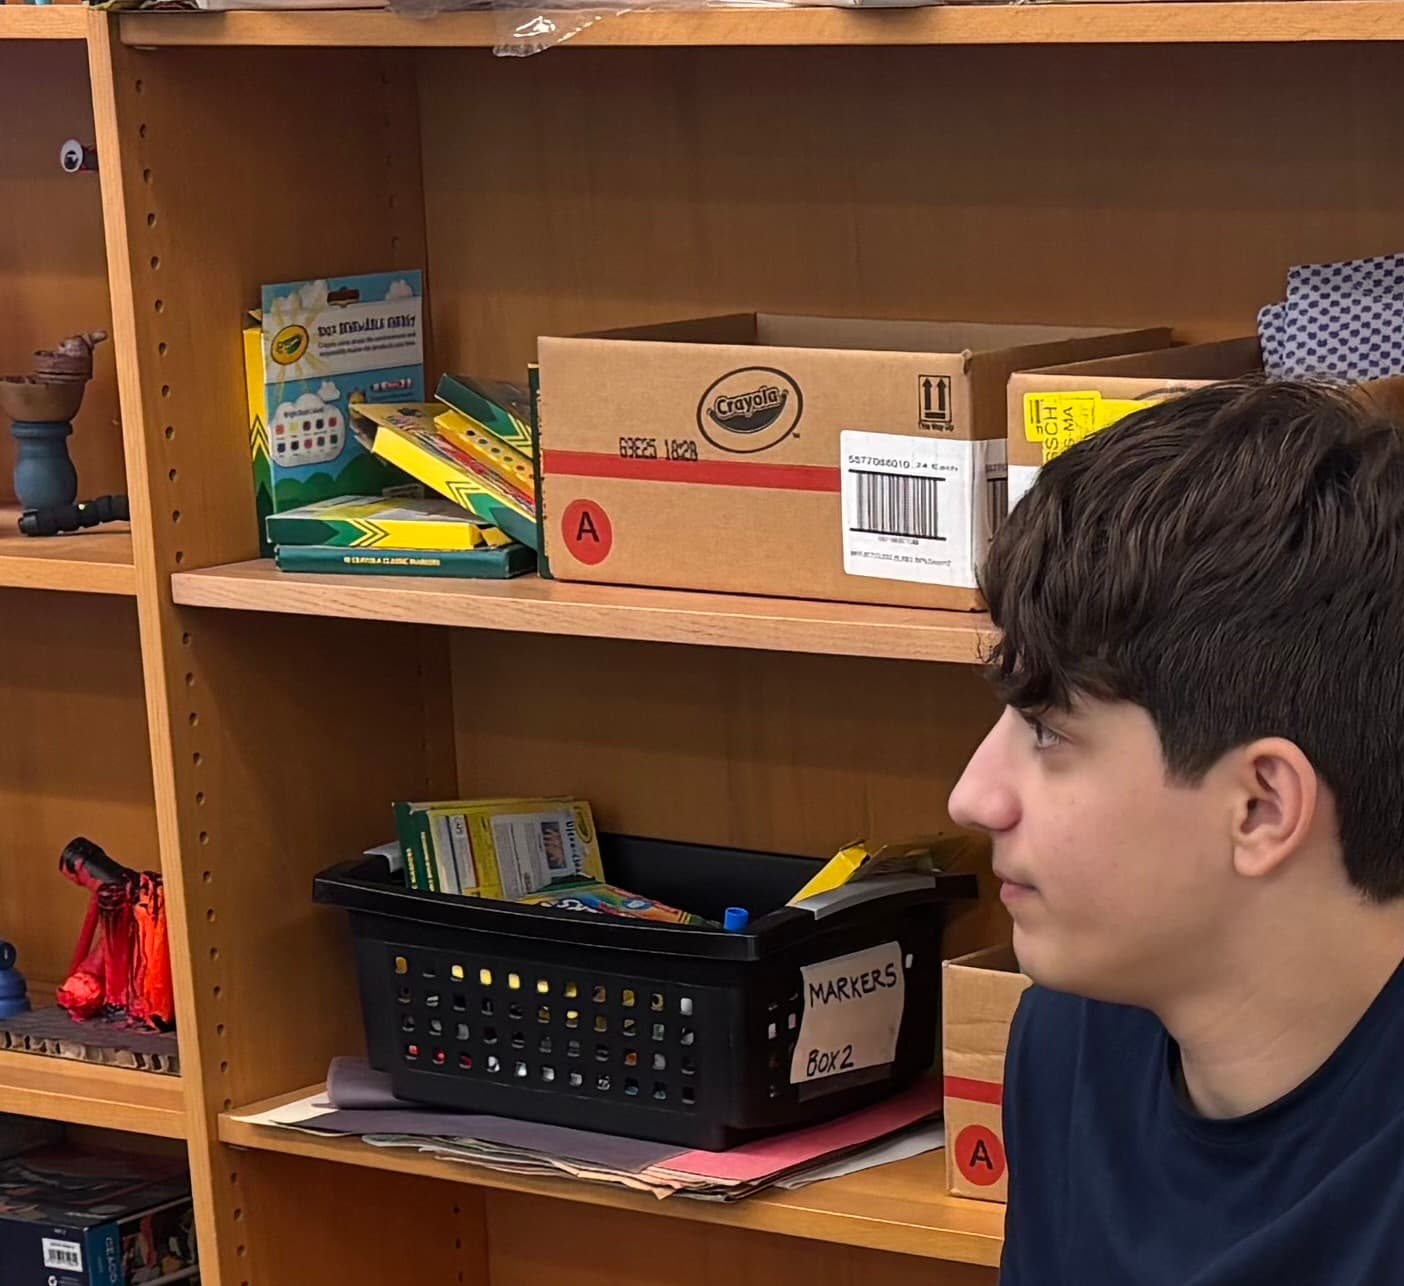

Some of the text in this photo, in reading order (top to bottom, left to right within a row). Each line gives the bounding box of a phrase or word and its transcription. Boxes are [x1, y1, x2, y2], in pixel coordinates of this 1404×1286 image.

[715, 385, 780, 418] Crayola
[575, 511, 600, 542] A
[808, 962, 898, 1008] MARKERS
[969, 1139, 994, 1170] A
